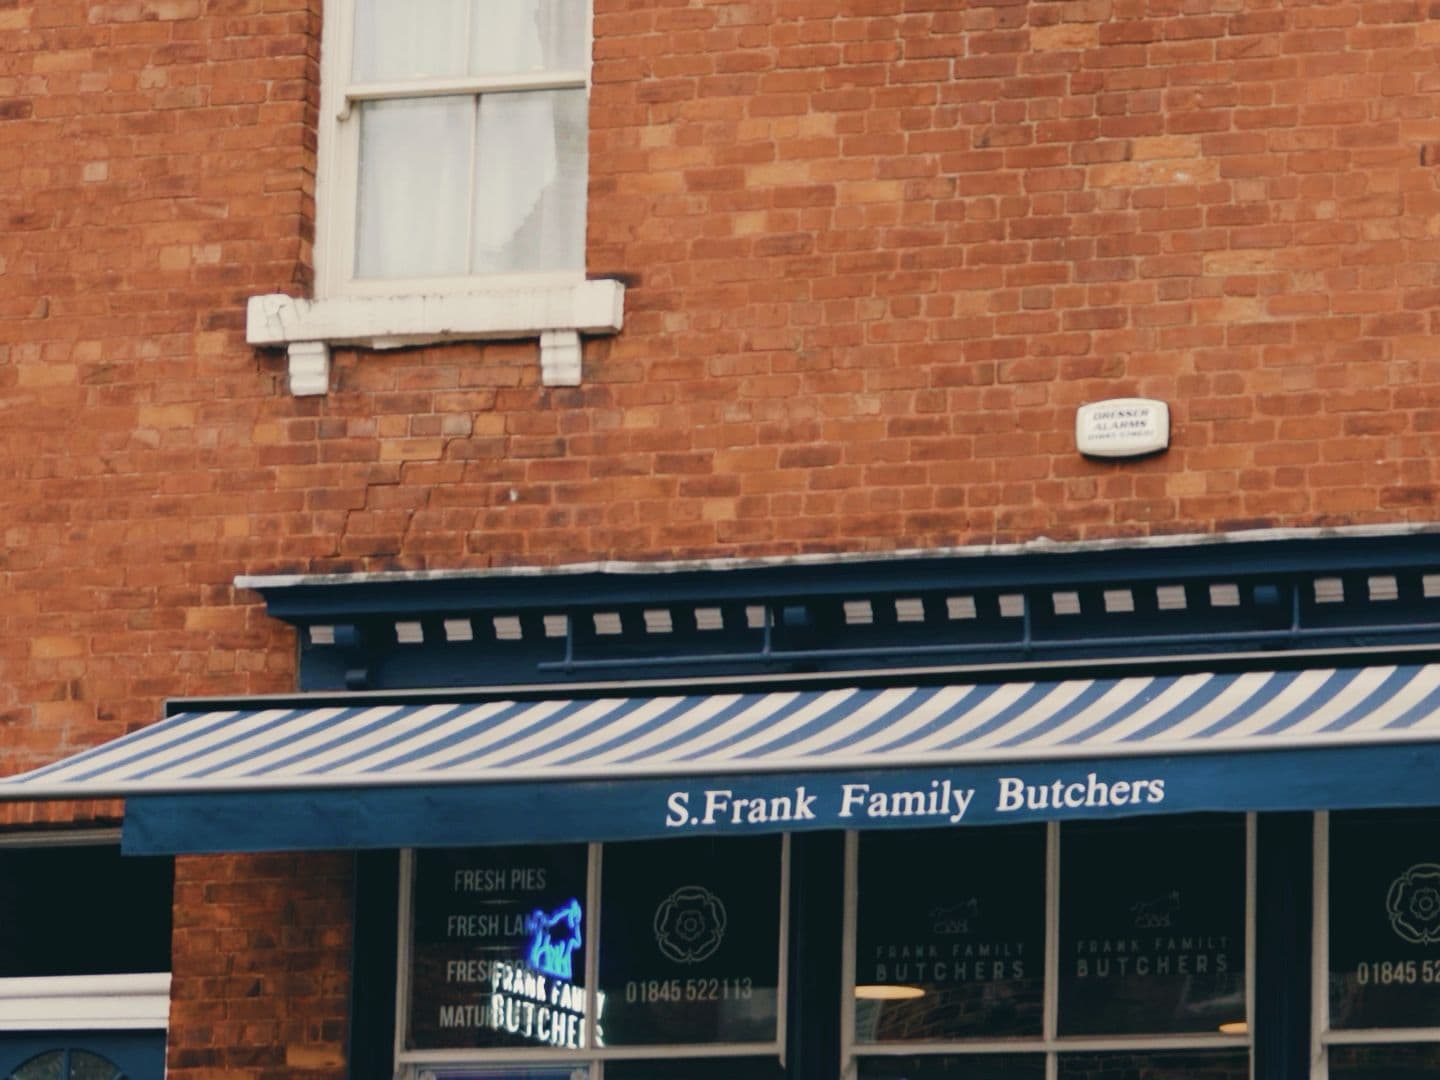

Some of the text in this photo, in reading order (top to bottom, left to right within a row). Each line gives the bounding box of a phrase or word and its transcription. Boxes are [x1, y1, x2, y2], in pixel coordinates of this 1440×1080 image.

[666, 773, 1166, 827] S.Frank Family Butchers
[454, 868, 546, 891] FRESH PIES
[448, 916, 498, 936] FRESH
[876, 960, 1024, 982] BUTCHERS
[1078, 954, 1227, 977] BUTCHERS
[1358, 960, 1416, 985] 01845
[493, 962, 546, 1002] FRANK
[627, 978, 752, 1002] 01845 522113
